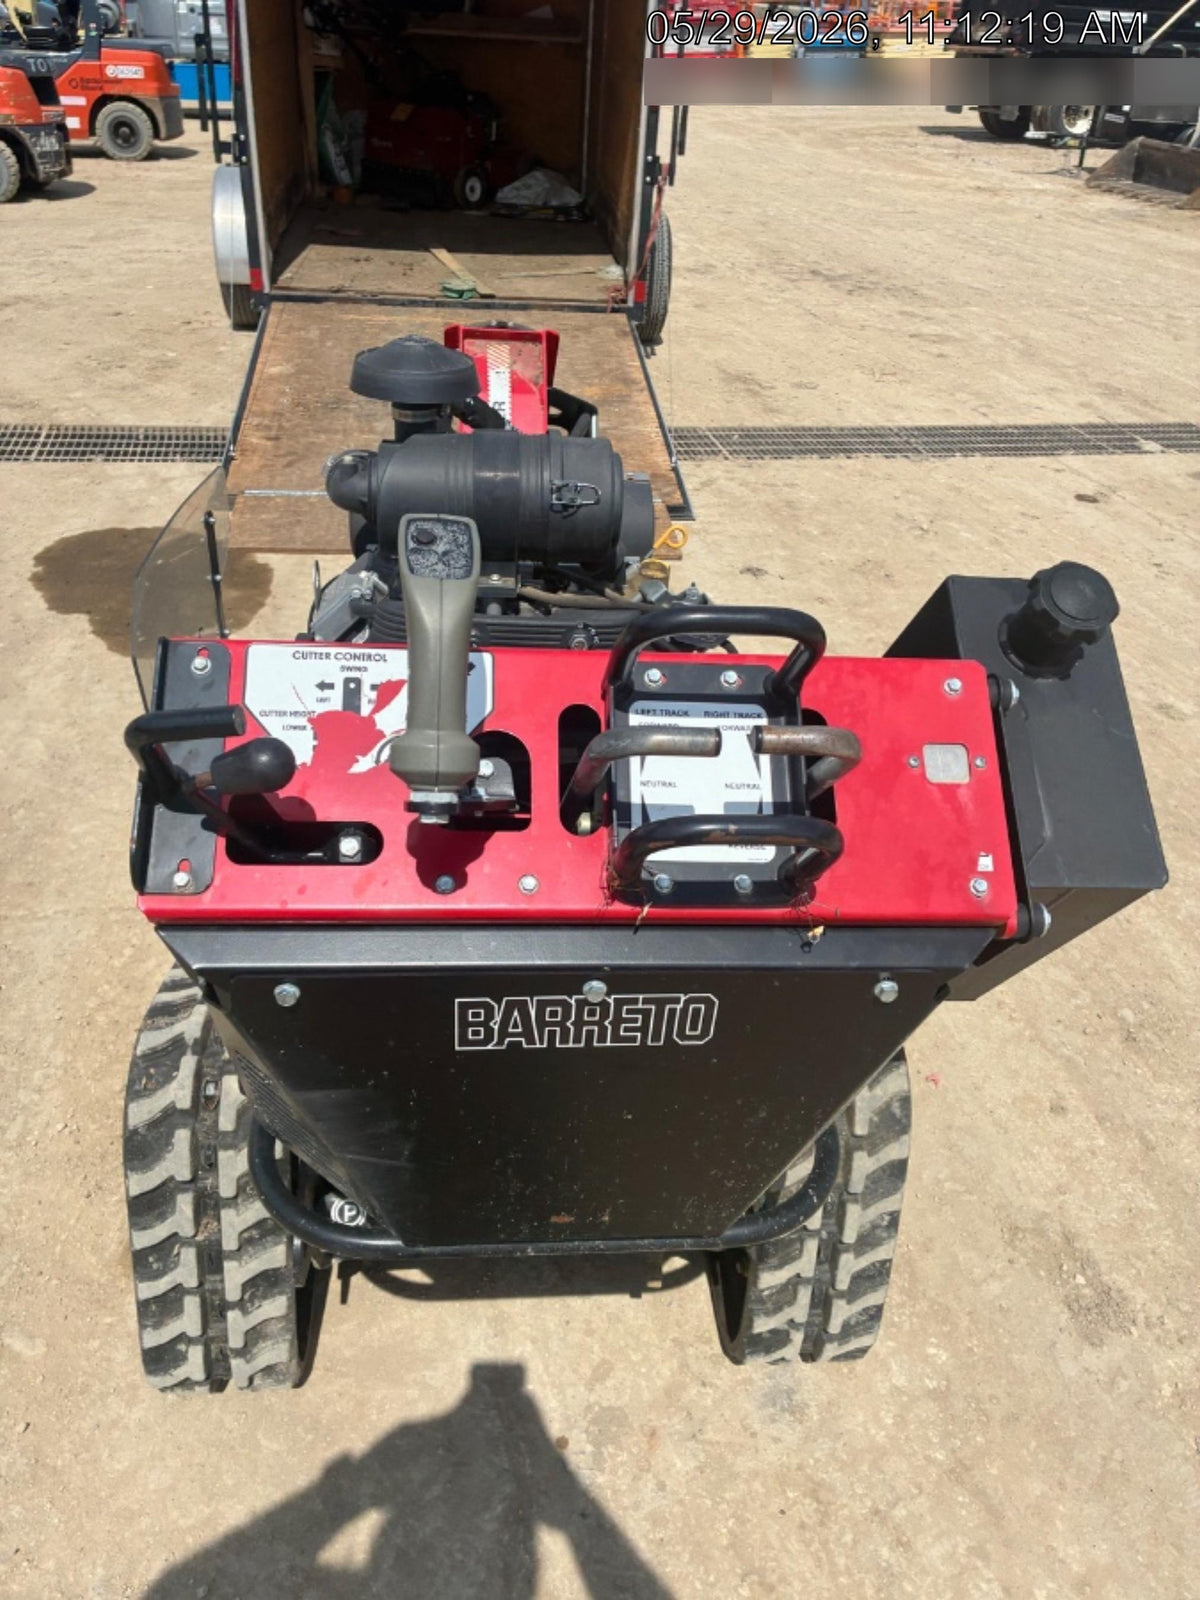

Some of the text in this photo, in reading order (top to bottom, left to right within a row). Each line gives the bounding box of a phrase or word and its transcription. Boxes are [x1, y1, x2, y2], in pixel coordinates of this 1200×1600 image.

[292, 650, 388, 663] CUTTER CONTROL
[259, 709, 288, 718] CUTTER
[636, 708, 690, 717] LEFT TRACK
[703, 710, 730, 719] RIGHT
[640, 780, 677, 788] NEUTRAL
[725, 782, 761, 790] NEUTRAL
[455, 993, 719, 1050] BARRETO
